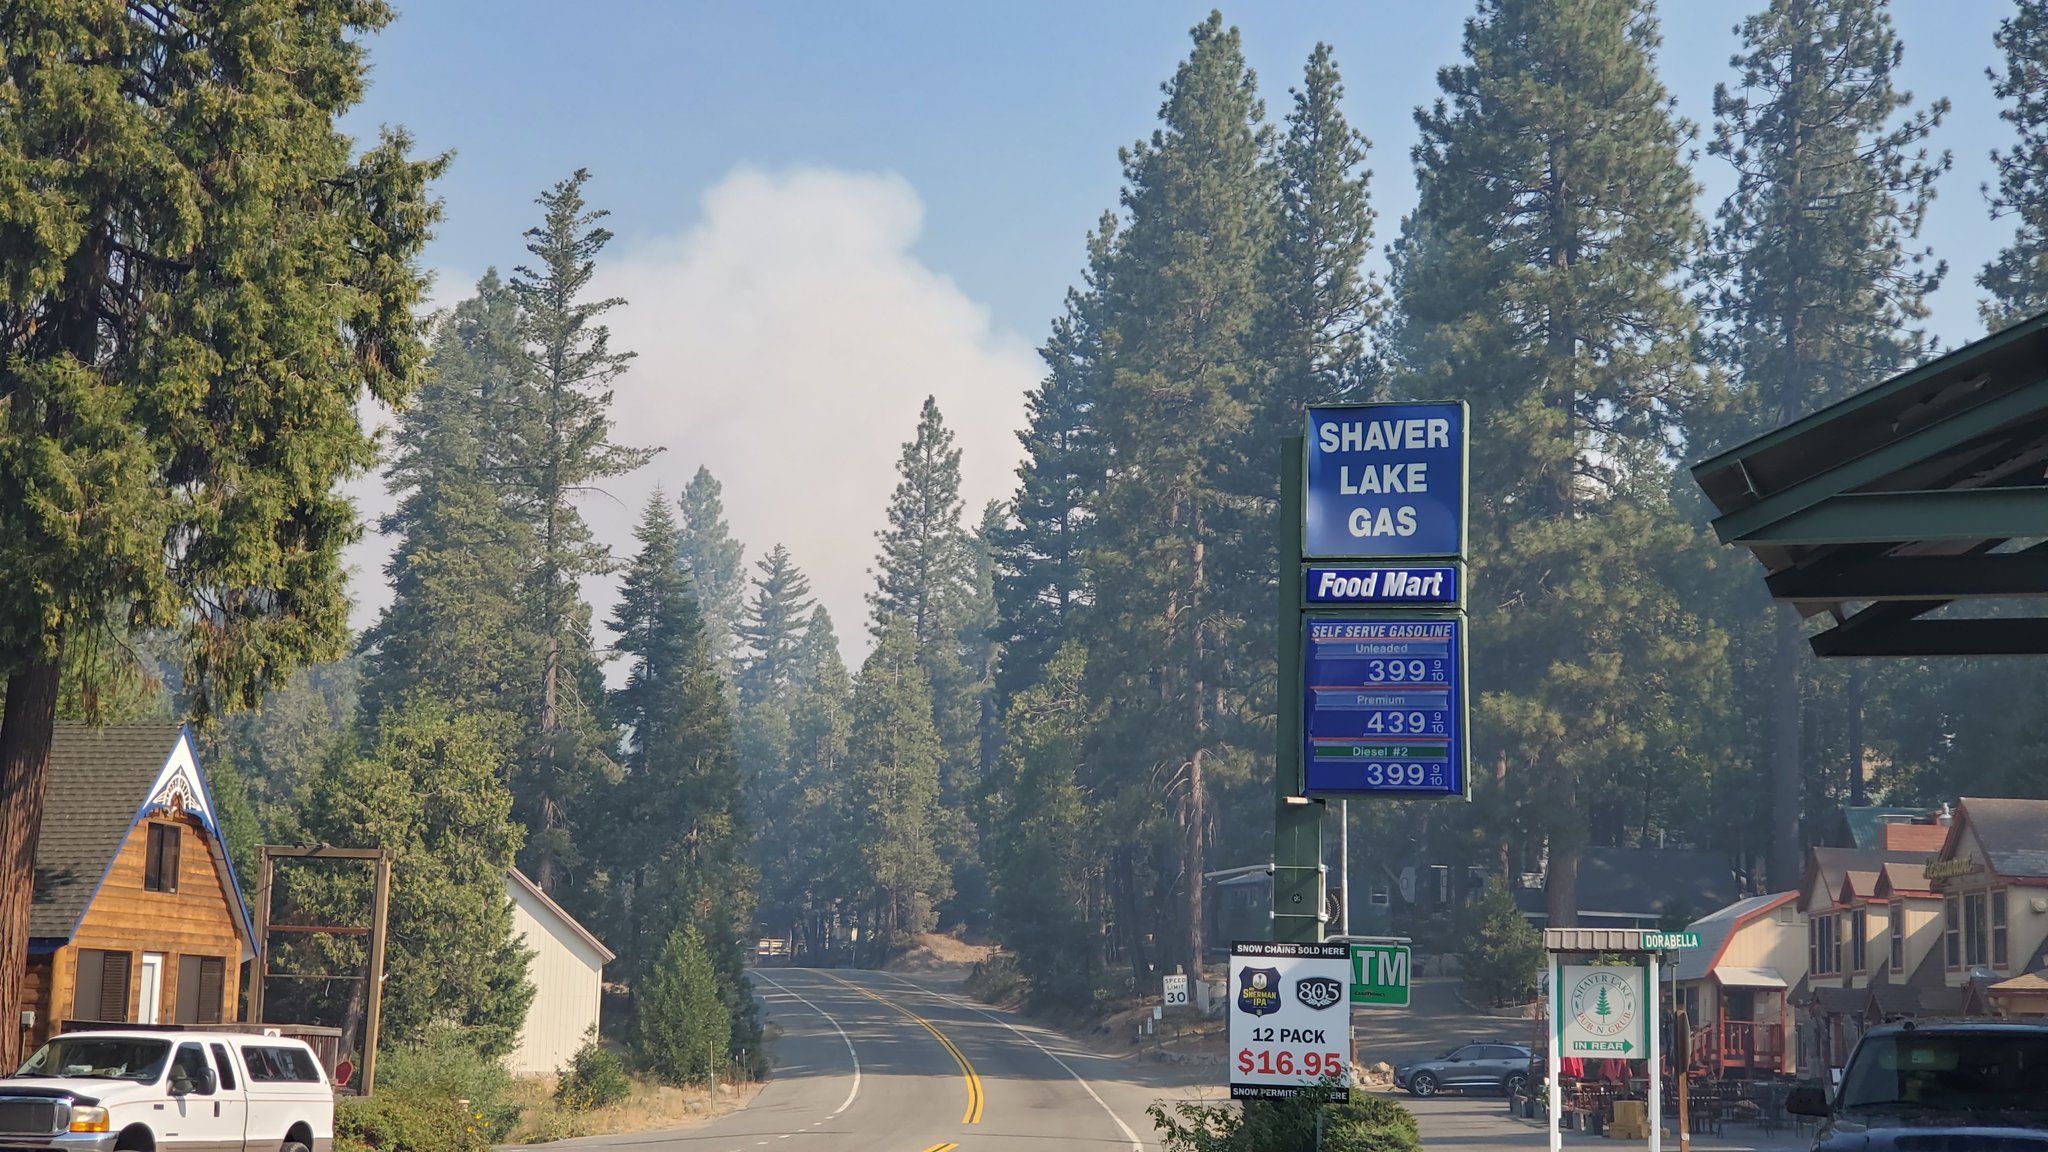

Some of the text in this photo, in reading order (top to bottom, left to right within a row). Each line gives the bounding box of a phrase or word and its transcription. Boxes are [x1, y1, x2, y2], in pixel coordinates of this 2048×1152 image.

[1319, 418, 1449, 453] SHAVER
[1340, 463, 1428, 495] LAKE
[1348, 506, 1417, 538] GAS
[1318, 572, 1443, 597] Food Mart
[1312, 624, 1452, 638] SELF SERVE GASOLINE
[1355, 643, 1408, 654] Unleaded
[1368, 659, 1426, 682] 399
[1357, 695, 1405, 705] Premium
[1367, 711, 1426, 734] 439
[1352, 747, 1408, 757] Diesel #2
[1367, 763, 1425, 785] 399
[1237, 944, 1345, 955] SNOW CHAINS SOLD HERE
[1645, 934, 1698, 948] DORABELLA
[1243, 988, 1277, 1000] SHERMAN
[1298, 982, 1340, 1001] 805
[1575, 975, 1632, 999] SHAVER LAKE
[1167, 992, 1186, 1003] 30
[1253, 998, 1267, 1006] IPA
[1577, 1012, 1631, 1034] PUB N GRUB
[1252, 1027, 1326, 1044] 12 PACK
[1574, 1041, 1624, 1050] IN REAR
[1237, 1047, 1342, 1077] $16.95
[1232, 1087, 1259, 1096] SNOW
[1260, 1088, 1298, 1097] PERMITS
